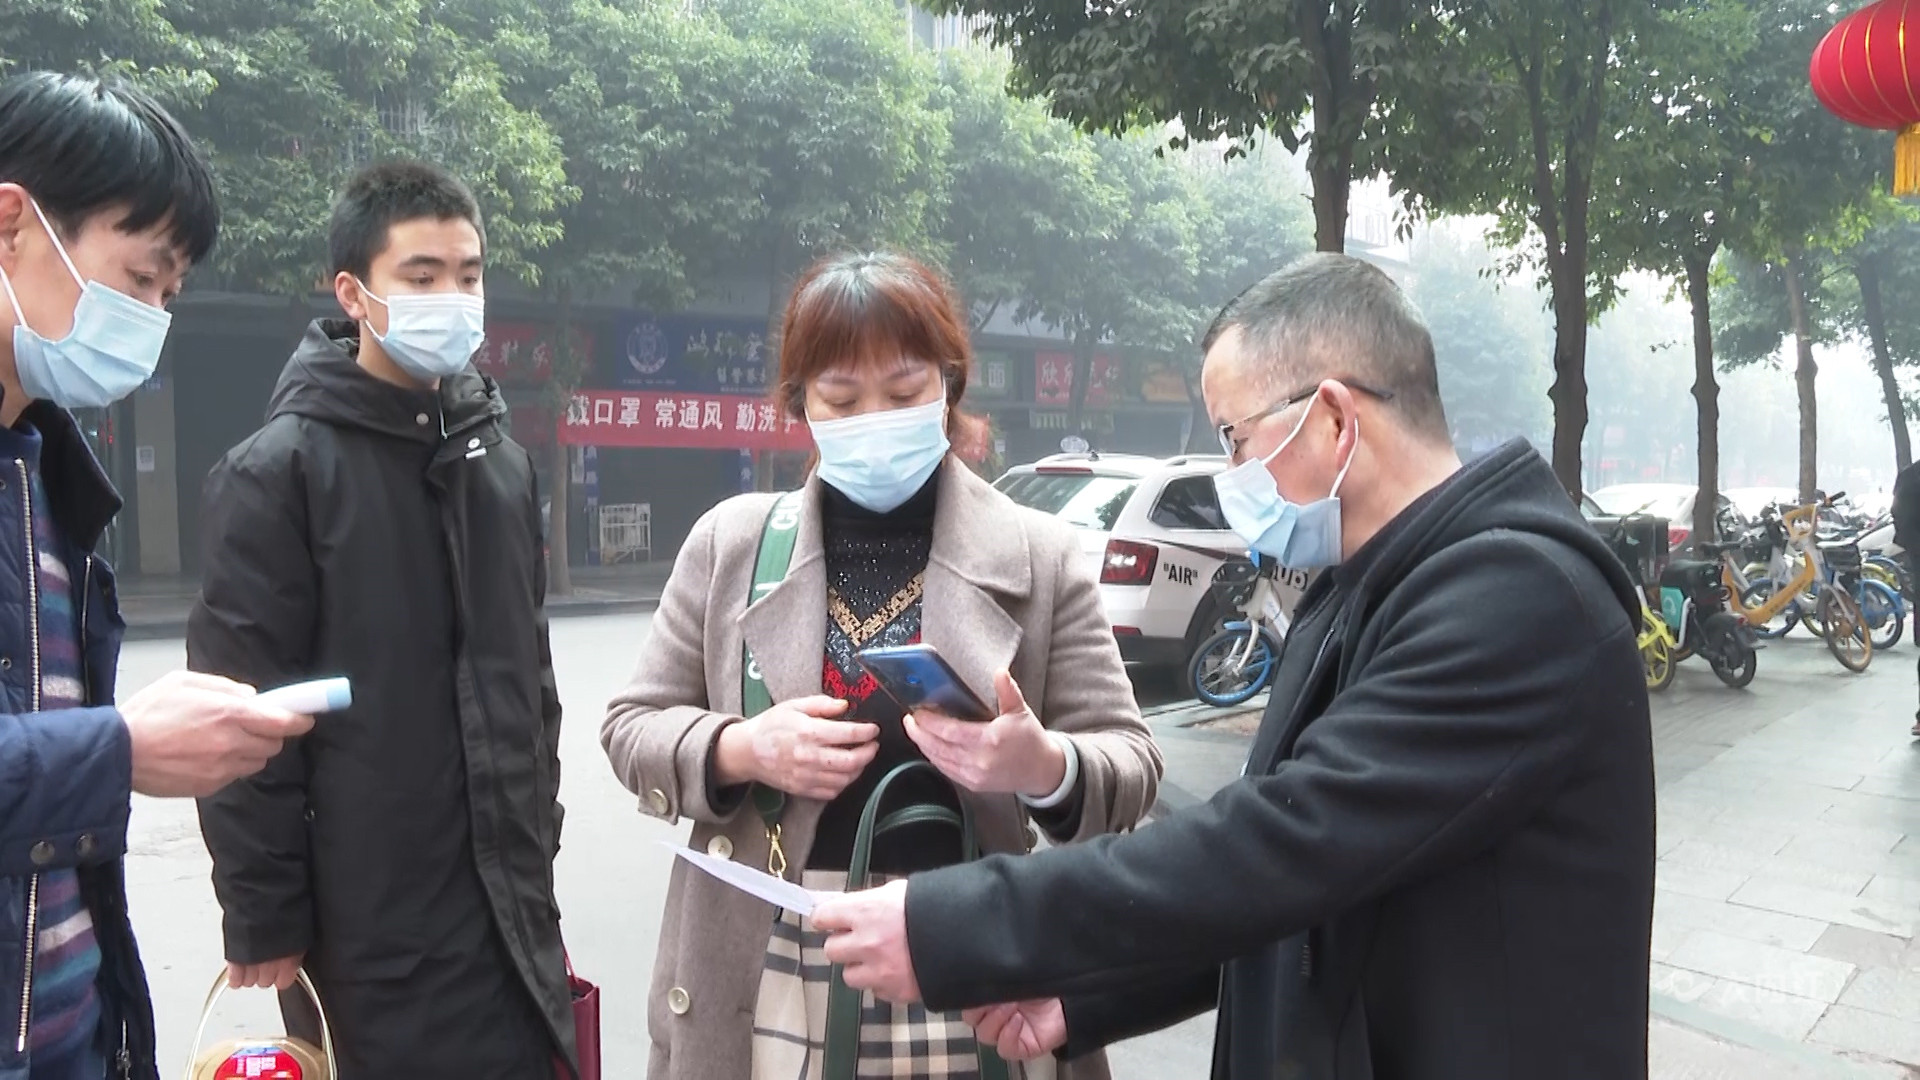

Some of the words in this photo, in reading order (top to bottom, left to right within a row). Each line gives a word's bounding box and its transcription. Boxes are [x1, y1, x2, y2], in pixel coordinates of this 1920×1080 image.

[567, 395, 641, 428] 戴口罩
[655, 397, 723, 430] 常通风
